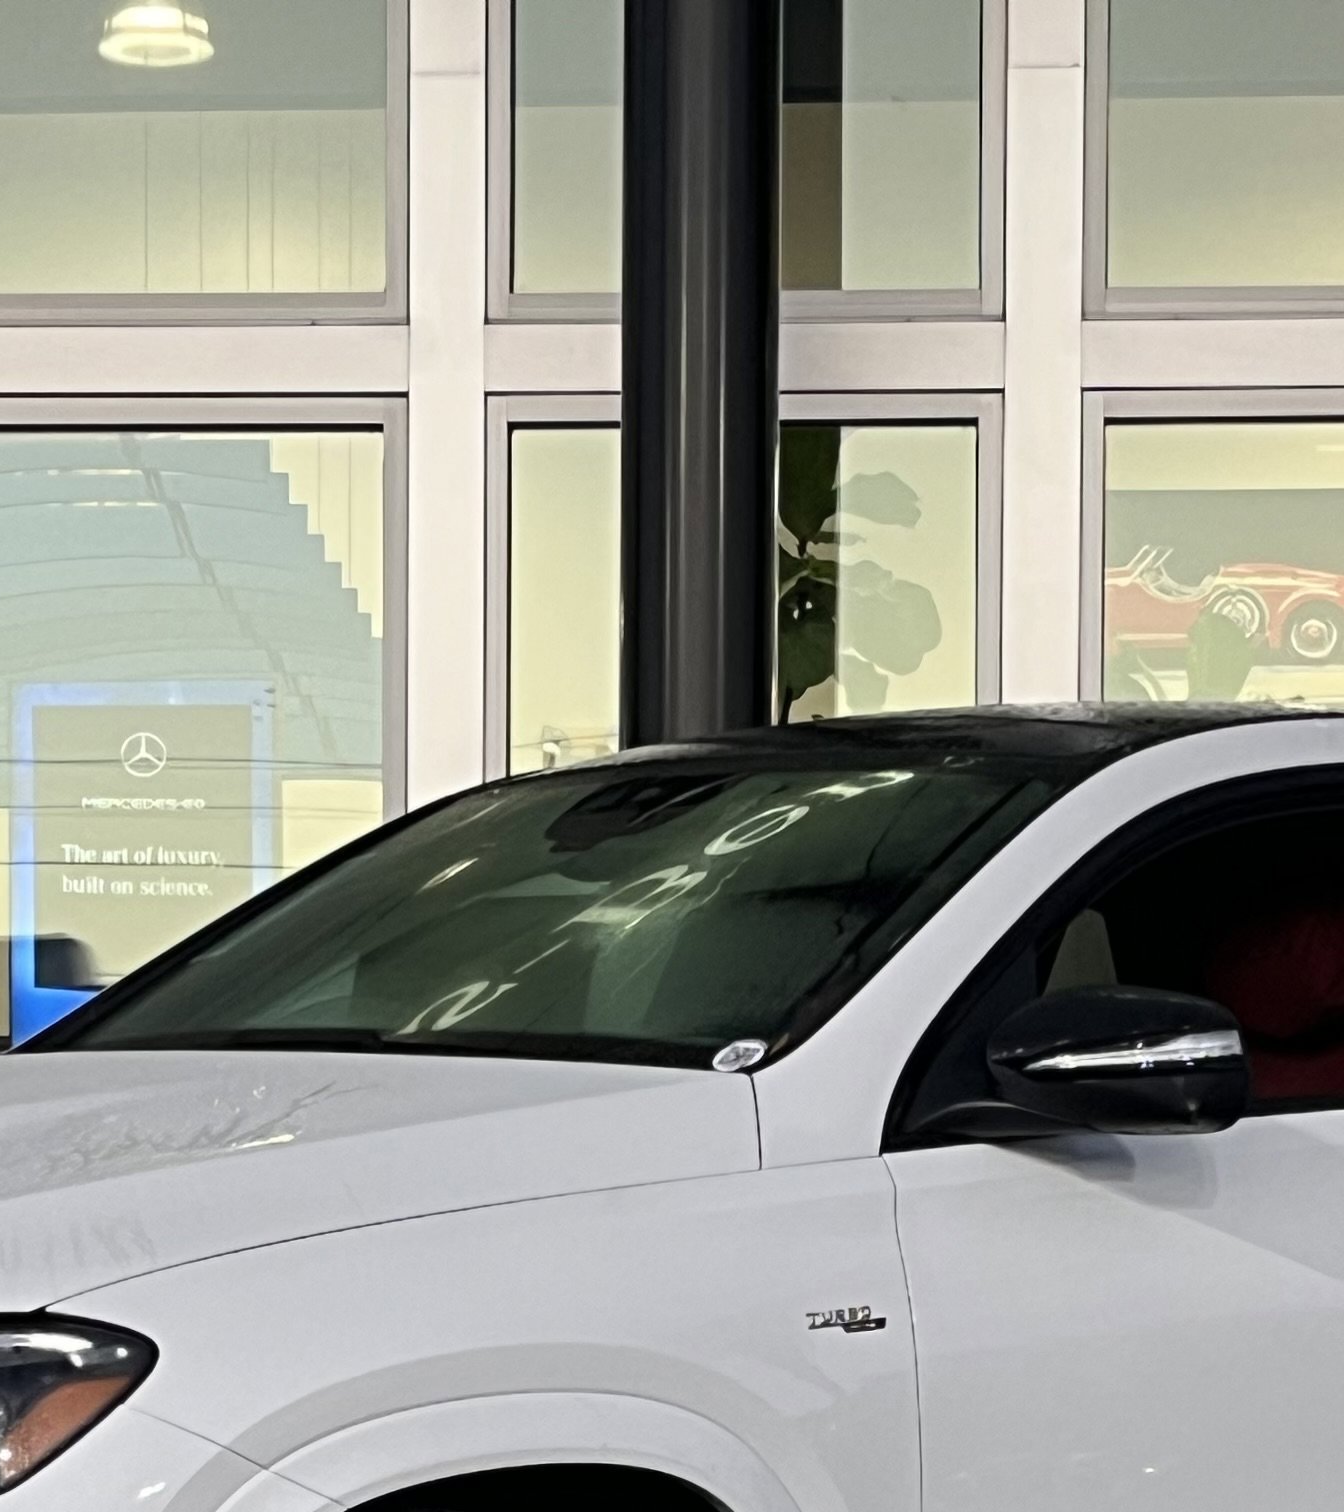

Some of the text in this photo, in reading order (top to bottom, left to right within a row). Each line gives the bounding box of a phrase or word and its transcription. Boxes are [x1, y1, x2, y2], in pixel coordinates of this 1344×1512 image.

[61, 843, 97, 864] The
[102, 847, 129, 865] art
[133, 846, 153, 865] of
[62, 875, 214, 897] built on science.
